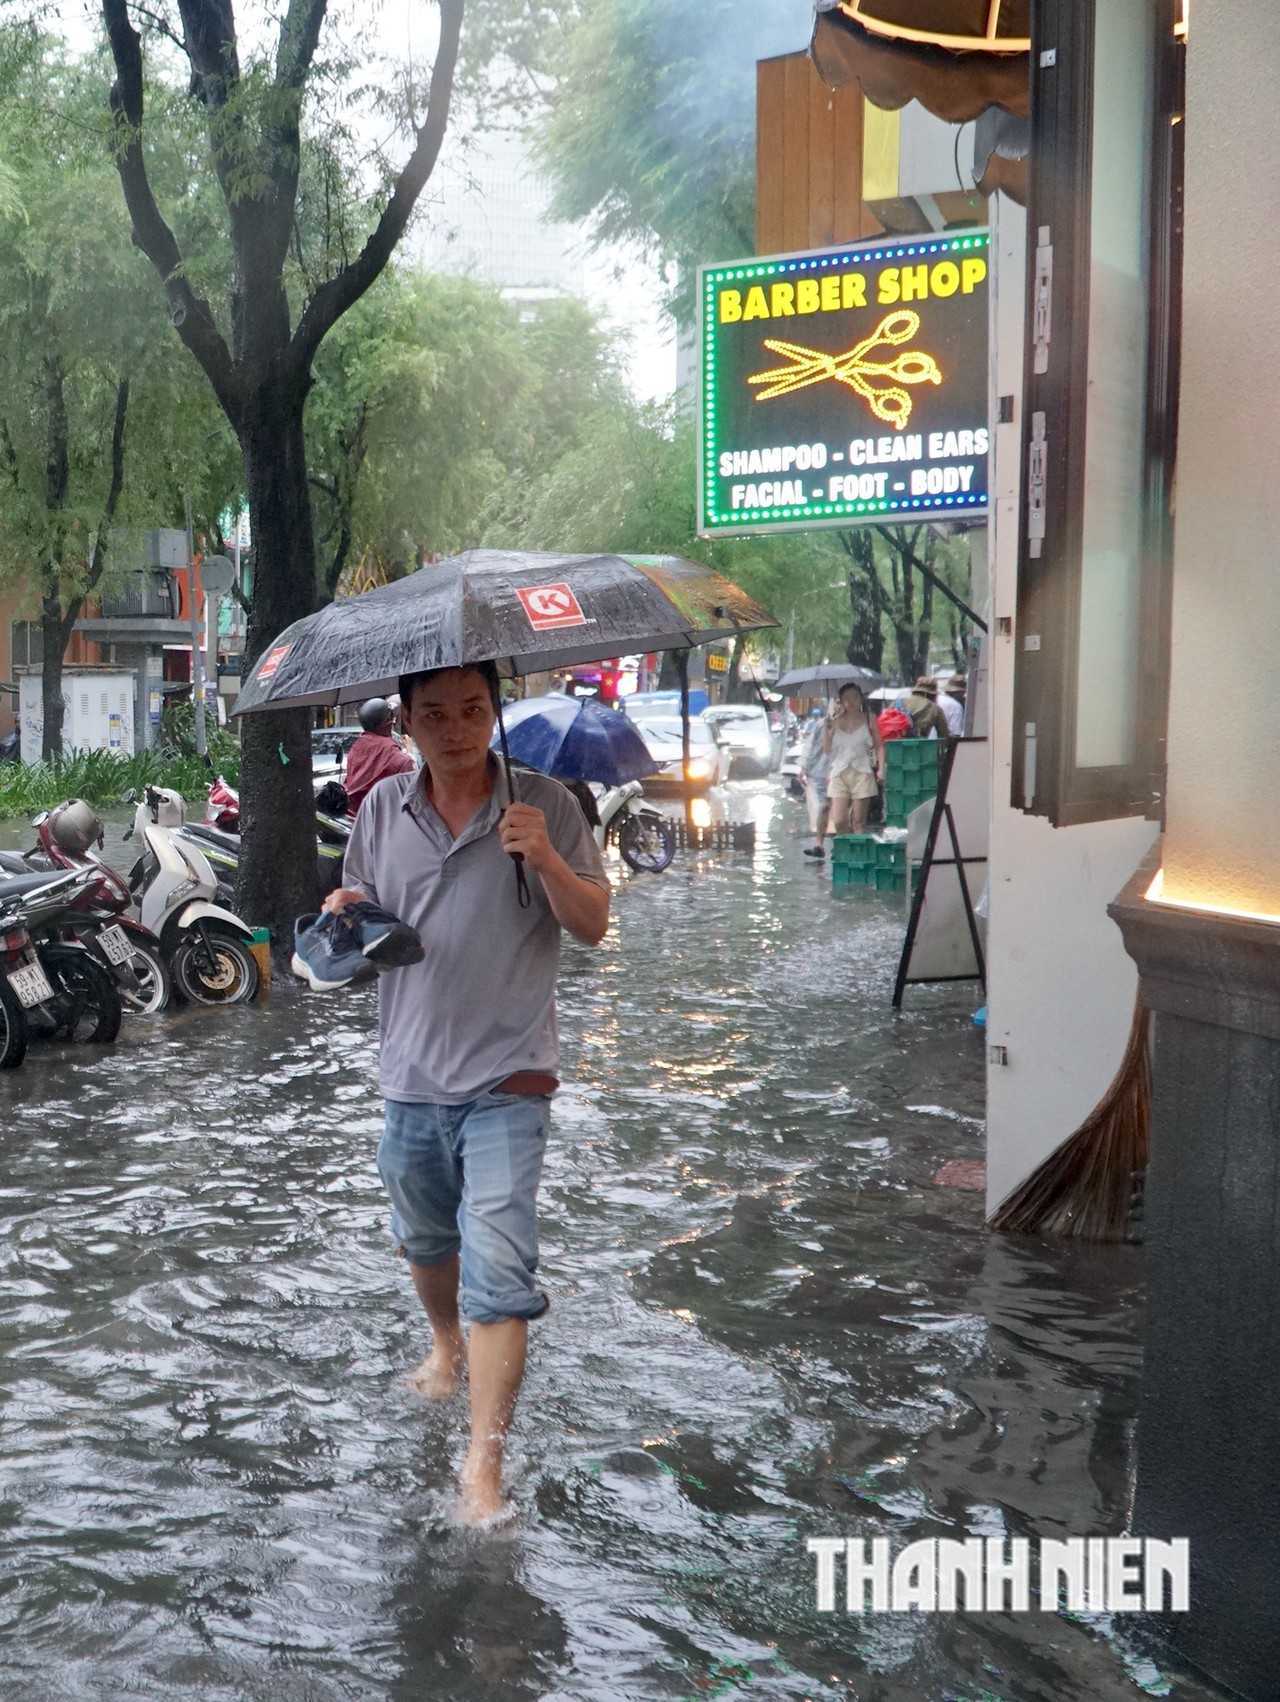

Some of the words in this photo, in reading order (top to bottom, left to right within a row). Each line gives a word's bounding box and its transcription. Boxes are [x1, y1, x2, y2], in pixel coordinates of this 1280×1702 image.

[720, 273, 867, 323] BARBER
[877, 258, 987, 305] SHOP
[719, 442, 827, 477] SHAMPOO
[849, 434, 922, 465] CLEAN
[928, 428, 989, 458] EARS
[732, 480, 808, 509] FACIAL
[829, 473, 889, 502] FOOT
[910, 466, 974, 495] BODY
